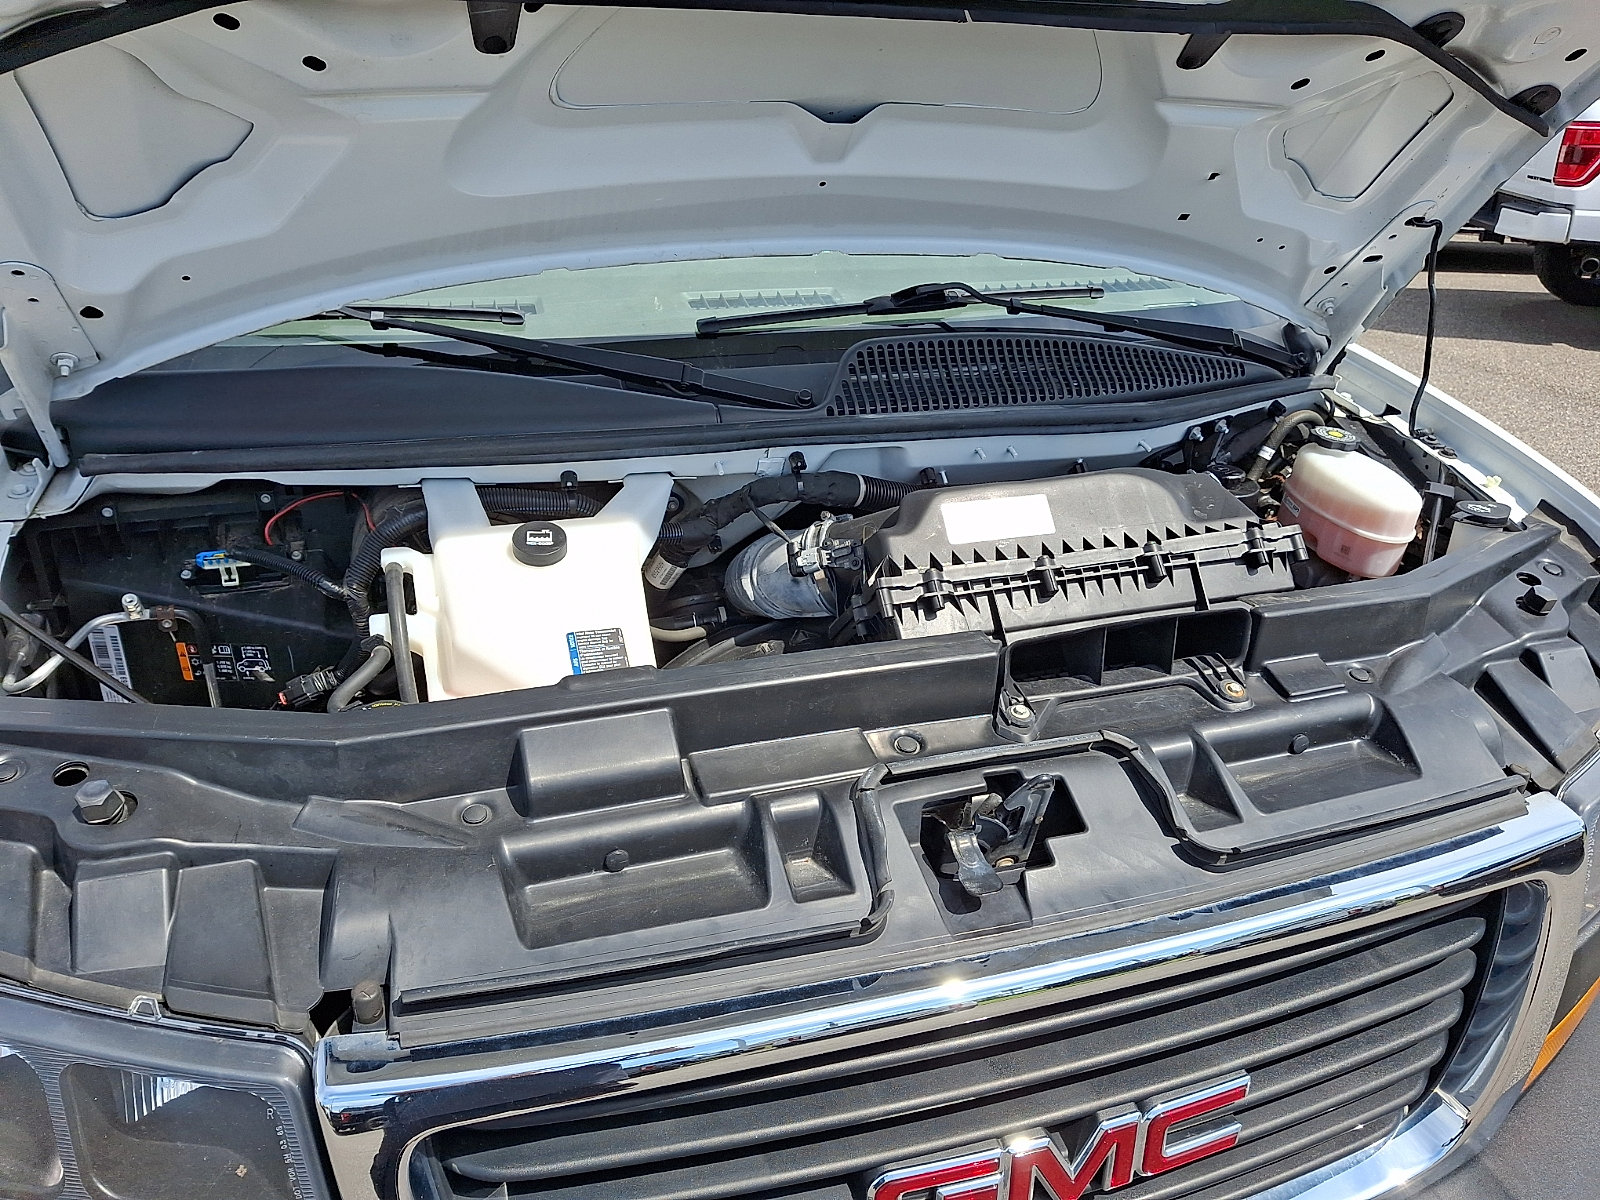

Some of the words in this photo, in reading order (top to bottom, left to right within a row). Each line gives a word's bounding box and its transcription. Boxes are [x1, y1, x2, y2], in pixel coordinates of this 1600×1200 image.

[266, 1108, 274, 1120] R
[866, 1068, 1251, 1200] GMC
[292, 1186, 303, 1200] DOT
